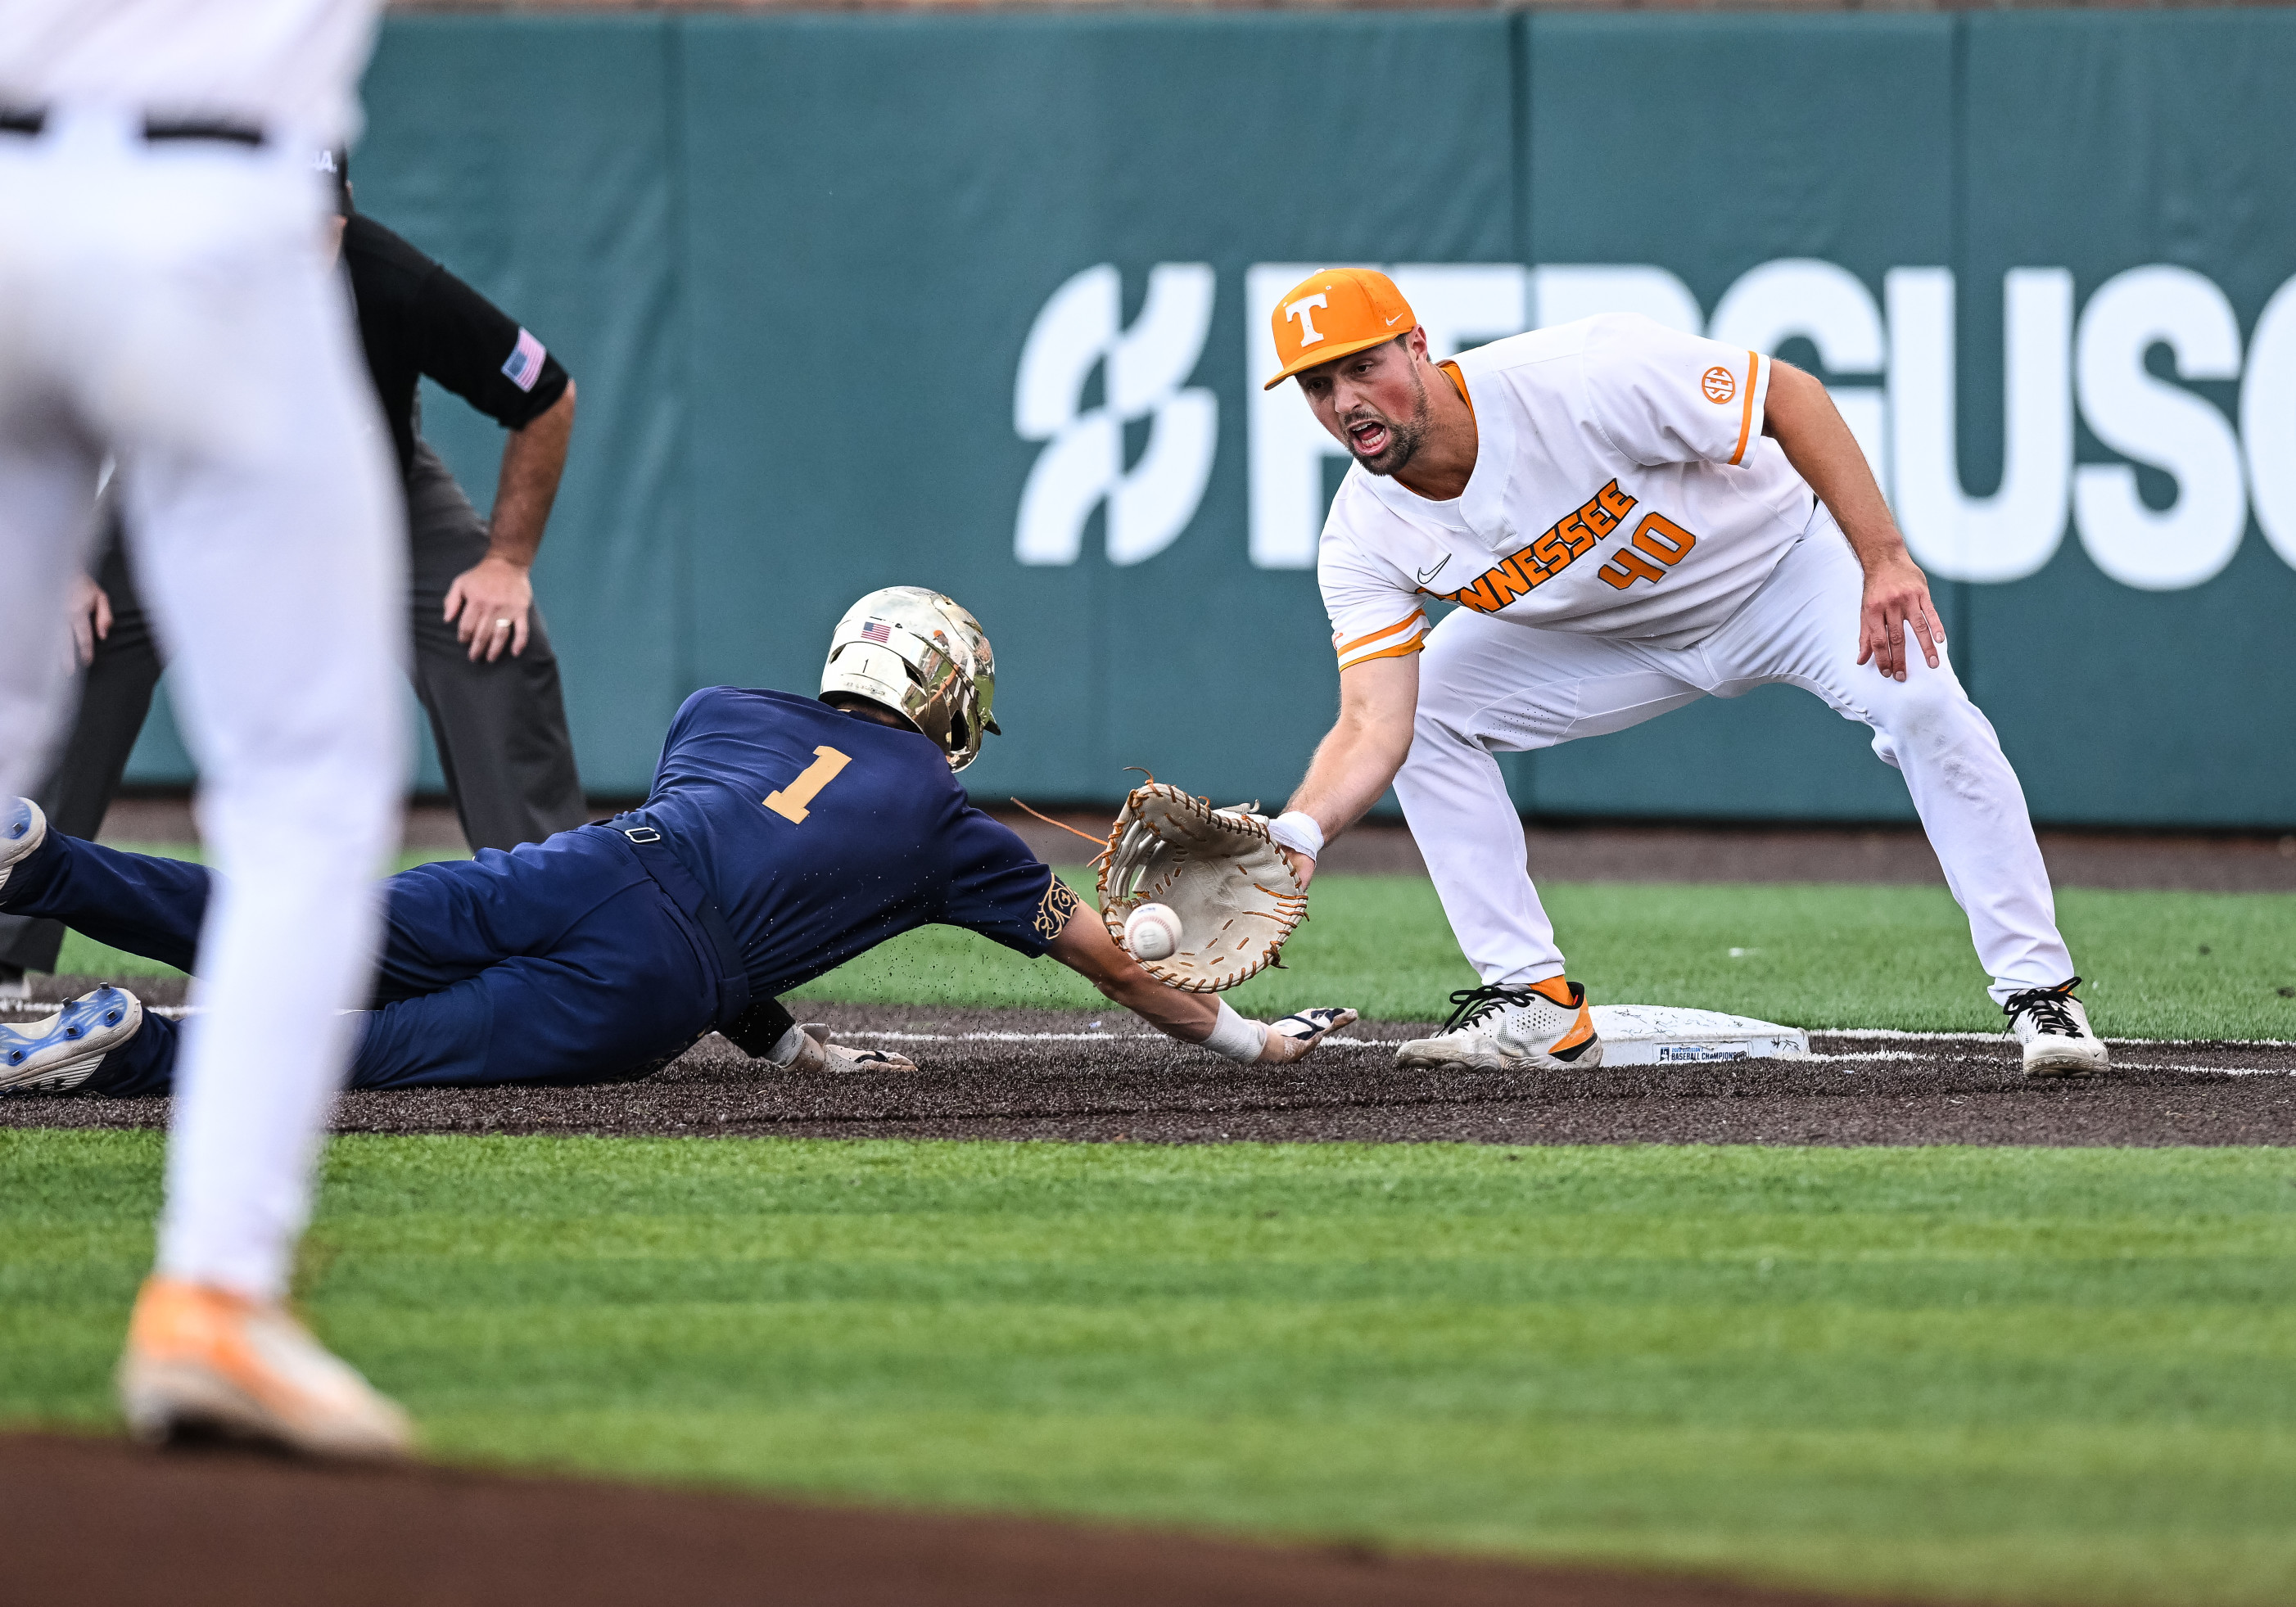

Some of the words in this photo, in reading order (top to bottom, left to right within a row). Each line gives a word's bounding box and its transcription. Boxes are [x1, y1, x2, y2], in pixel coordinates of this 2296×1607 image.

[1285, 292, 1328, 348] T
[1703, 368, 1734, 401] SEC
[1415, 477, 1639, 614] NNESSEE
[1597, 511, 1697, 590] 40
[762, 745, 852, 824] 1
[1671, 1052, 1700, 1061] BASEBALL
